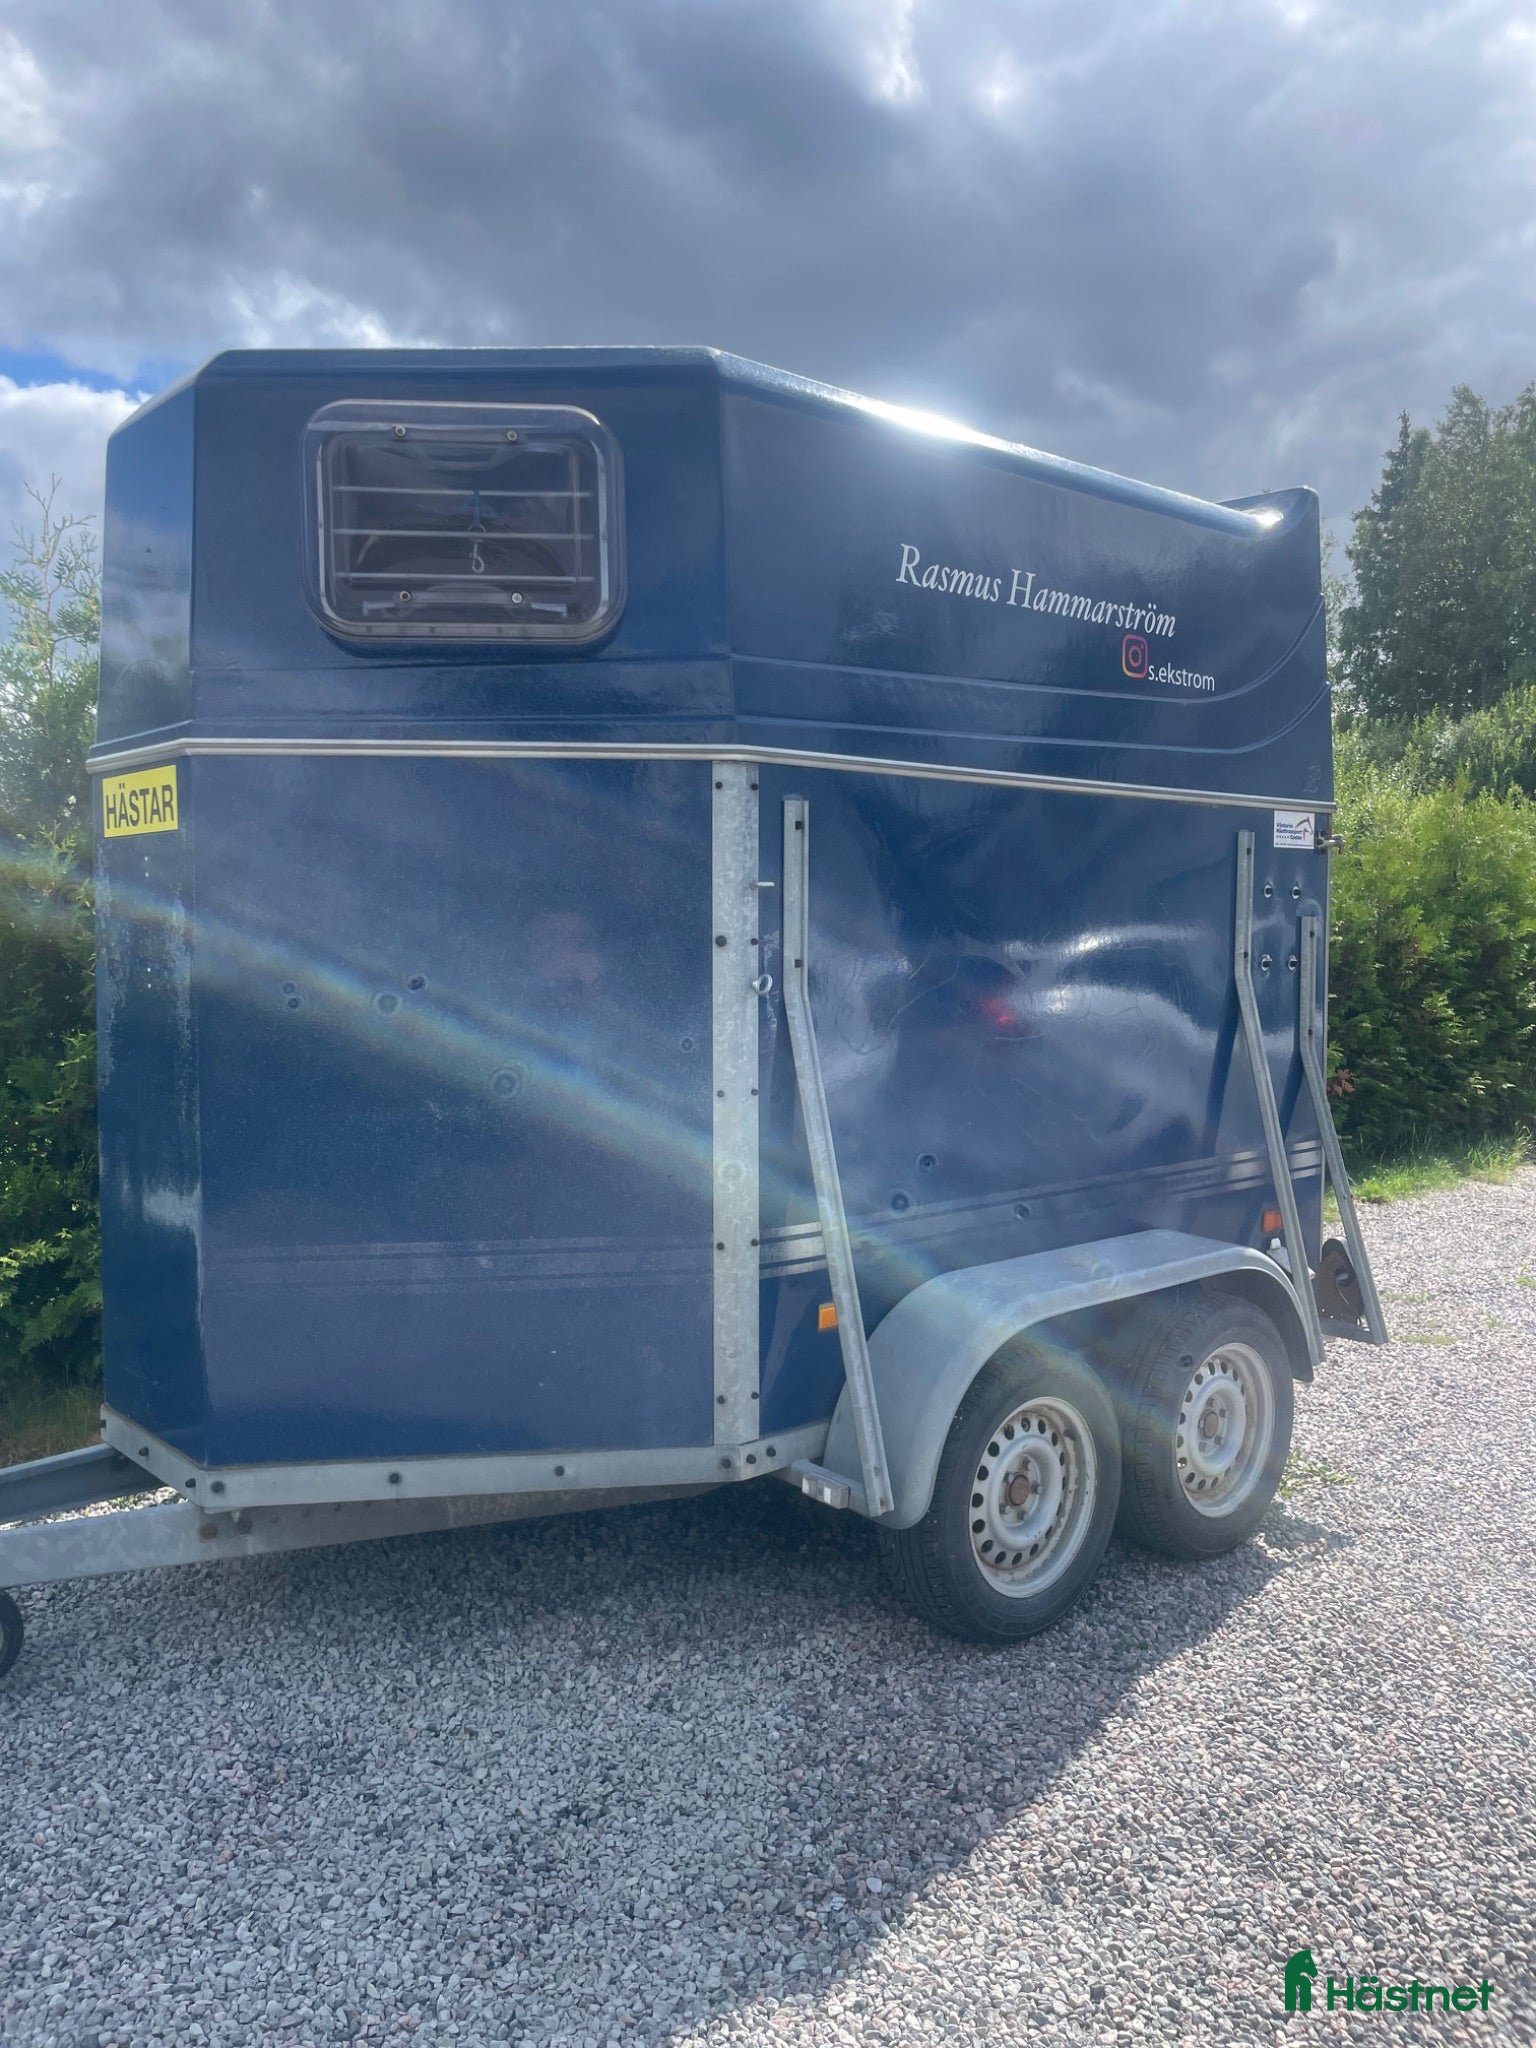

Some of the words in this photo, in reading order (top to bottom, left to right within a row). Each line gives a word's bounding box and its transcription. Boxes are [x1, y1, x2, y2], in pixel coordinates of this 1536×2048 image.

[896, 543, 1002, 602] Rasmus
[1006, 569, 1177, 638] Hammarström
[1148, 662, 1215, 692] s.ekstrom
[106, 782, 175, 829] HÄSTAR
